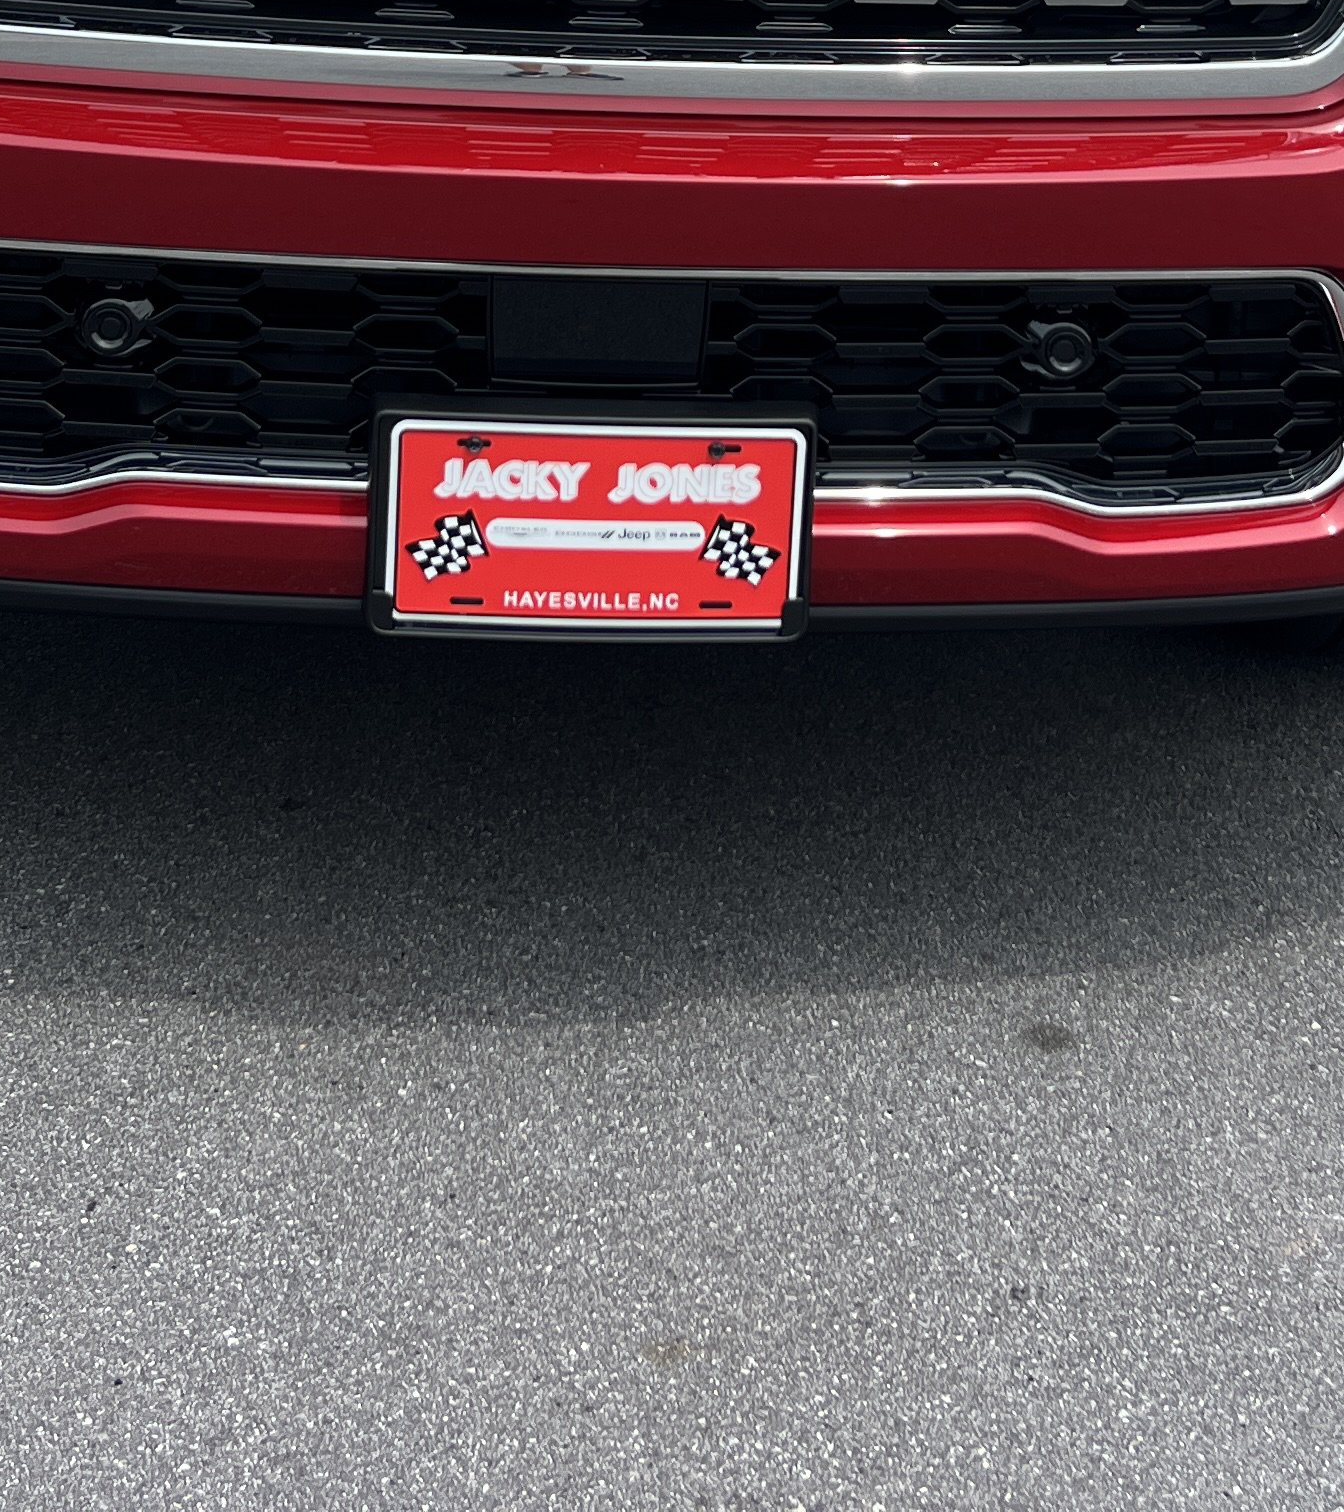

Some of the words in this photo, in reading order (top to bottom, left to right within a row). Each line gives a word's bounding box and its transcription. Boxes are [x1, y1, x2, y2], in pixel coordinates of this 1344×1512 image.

[433, 457, 591, 502] JACKY
[607, 462, 762, 505] JONES
[617, 527, 651, 541] Jeep
